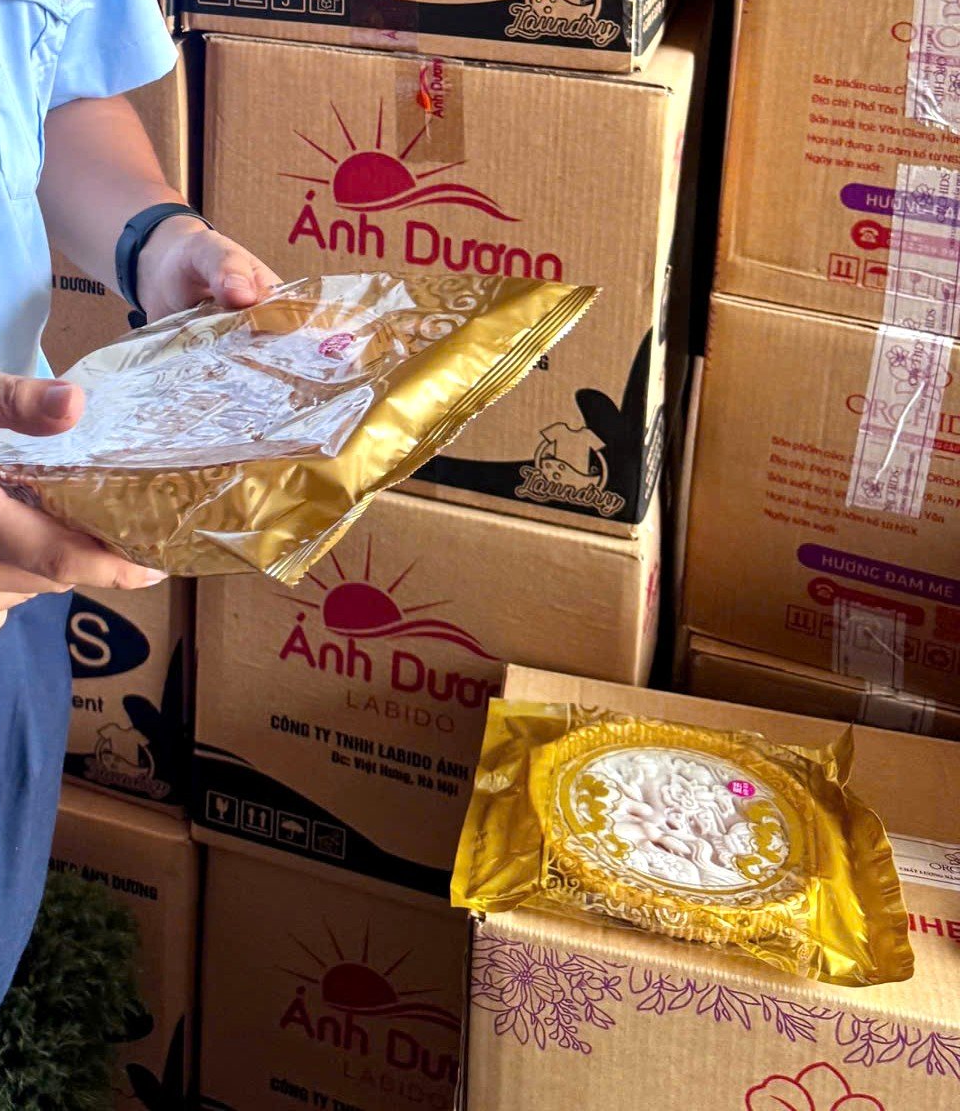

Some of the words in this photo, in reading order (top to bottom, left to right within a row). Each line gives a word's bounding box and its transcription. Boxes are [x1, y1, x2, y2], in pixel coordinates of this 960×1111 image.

[505, 3, 620, 47] Laundry
[288, 190, 385, 258] Ánh
[60, 276, 105, 296] DƯƠNG
[515, 466, 626, 517] Laundry
[279, 611, 373, 682] Ánh
[347, 690, 454, 734] LABIDO
[271, 714, 310, 738] CÔNG
[315, 726, 331, 743] TY
[336, 731, 374, 756] TNHH
[378, 740, 431, 771] LABIDO
[436, 756, 468, 781] ÁNH
[279, 986, 369, 1055] Ánh
[313, 1091, 328, 1109] TY
